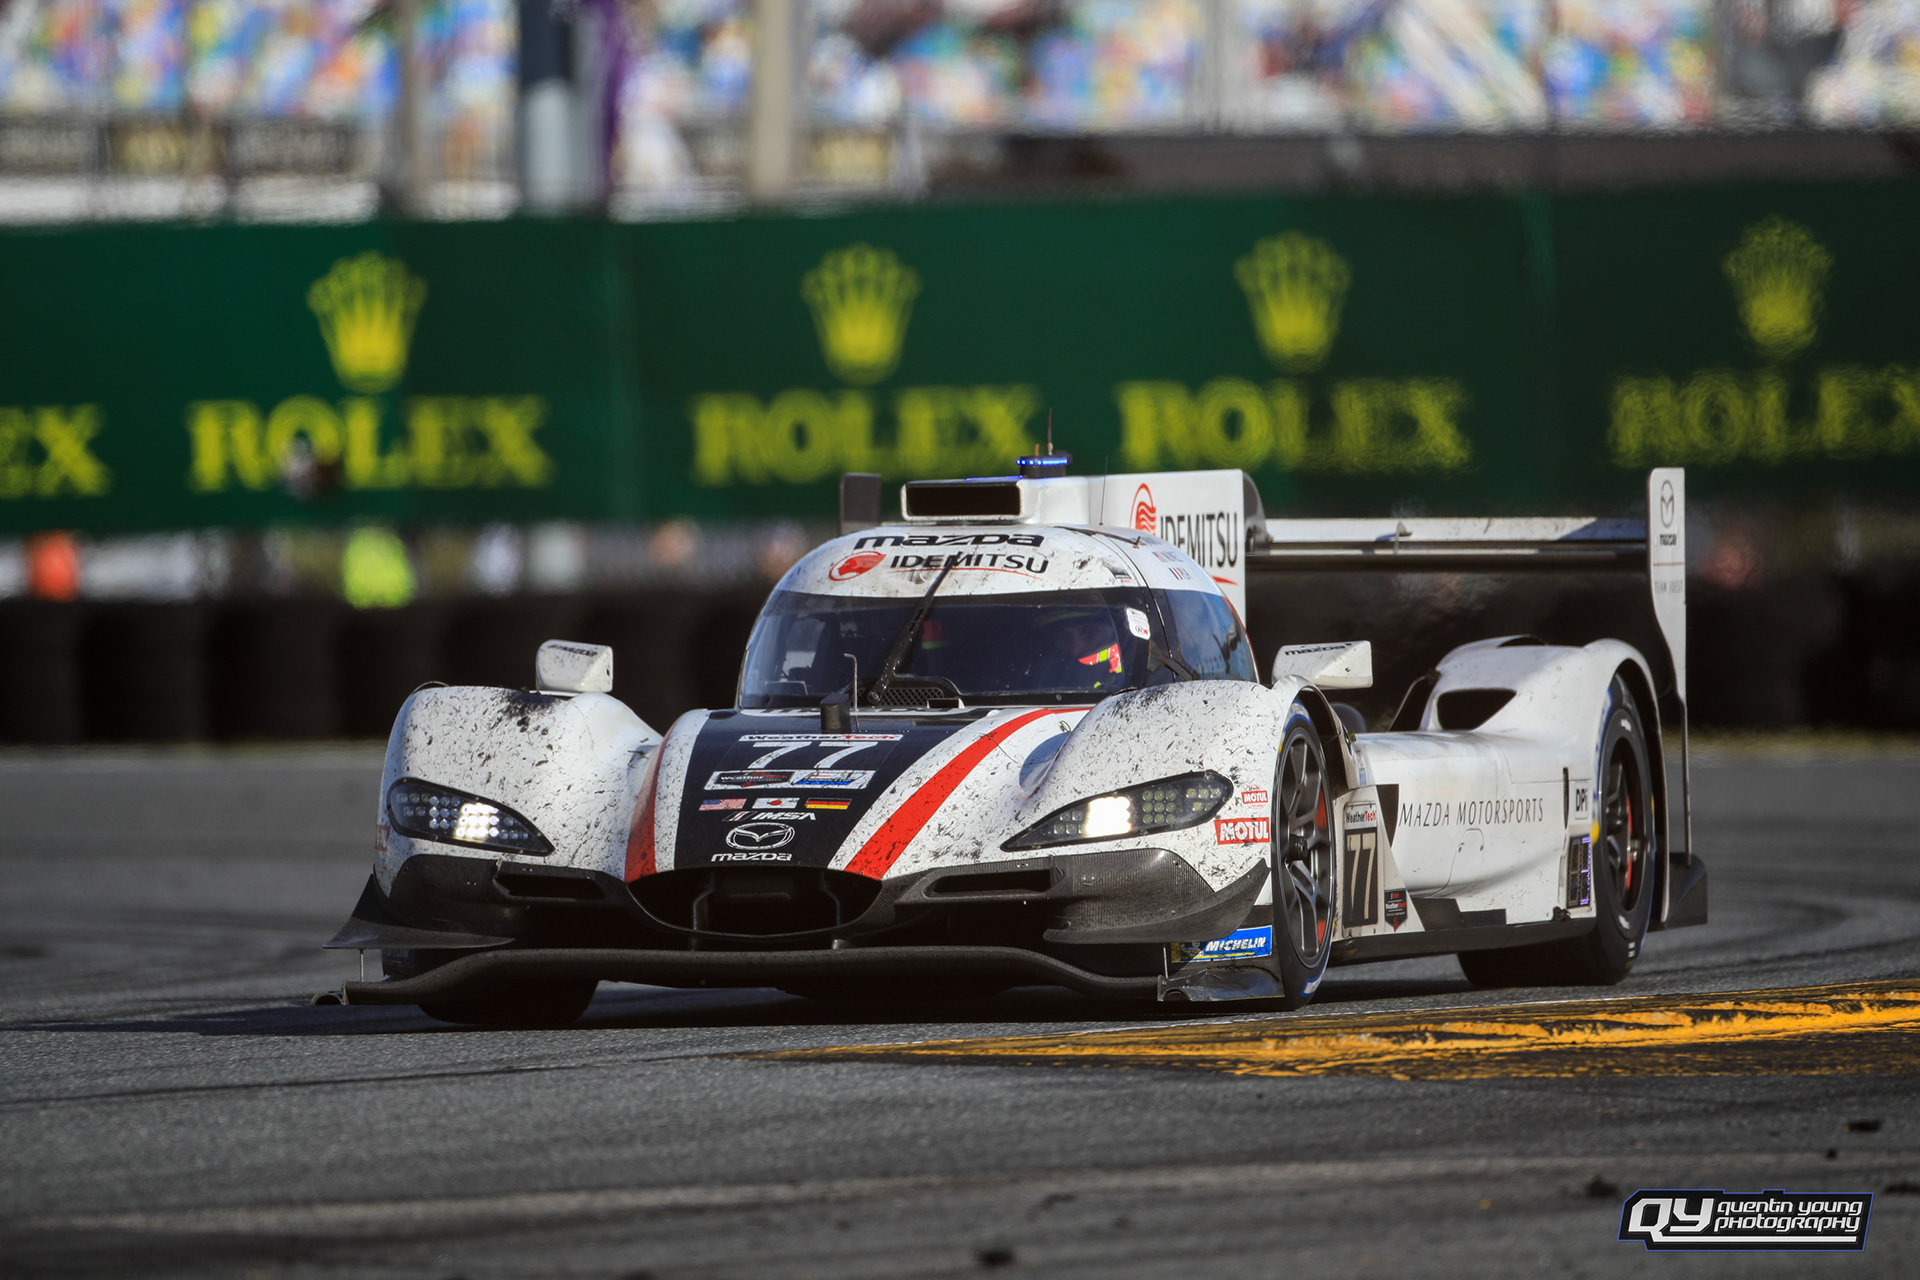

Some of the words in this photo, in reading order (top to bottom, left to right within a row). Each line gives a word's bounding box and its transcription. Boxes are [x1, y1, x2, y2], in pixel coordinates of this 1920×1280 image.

[690, 384, 1040, 484] ROLEX
[1116, 378, 1470, 474] ROLEX
[188, 396, 552, 492] ROLEX
[853, 534, 1045, 550] mazda
[890, 552, 1050, 574] IDEMITSU
[748, 734, 896, 742] WeatherTech
[748, 741, 879, 770] 77
[1243, 792, 1267, 803] MOTUL
[751, 811, 817, 821] IMSA
[1346, 810, 1377, 824] WeatherTech
[1399, 802, 1450, 827] MAZDA
[1456, 797, 1544, 826] MOTORSPORTS
[1220, 820, 1269, 841] MOTUL
[711, 852, 793, 863] mazda
[1346, 832, 1376, 920] 77
[1205, 936, 1267, 952] MICHELIN
